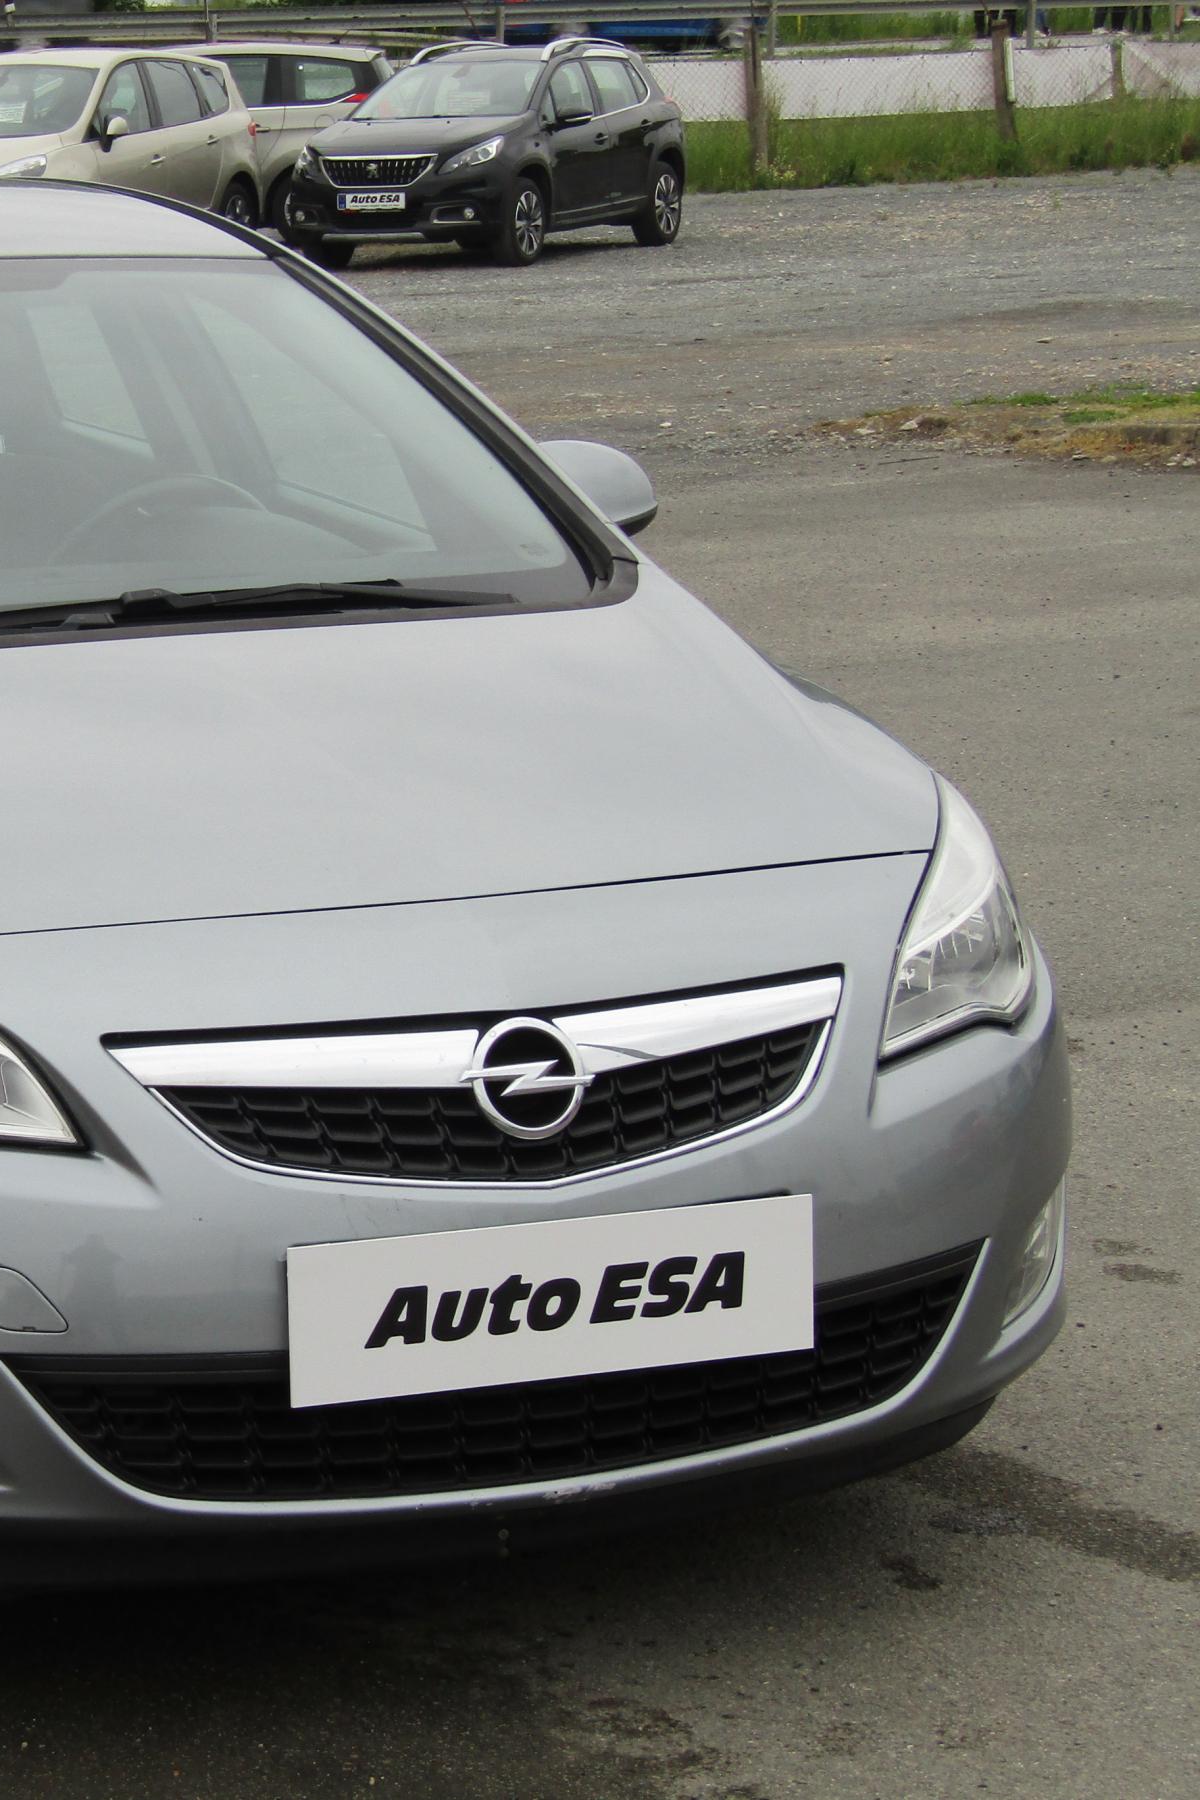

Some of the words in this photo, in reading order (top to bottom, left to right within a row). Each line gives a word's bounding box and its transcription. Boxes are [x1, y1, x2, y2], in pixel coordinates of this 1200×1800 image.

[350, 195, 377, 203] Auto
[379, 194, 400, 203] ESA
[365, 1275, 580, 1349] Auto
[590, 1252, 745, 1324] ESA
